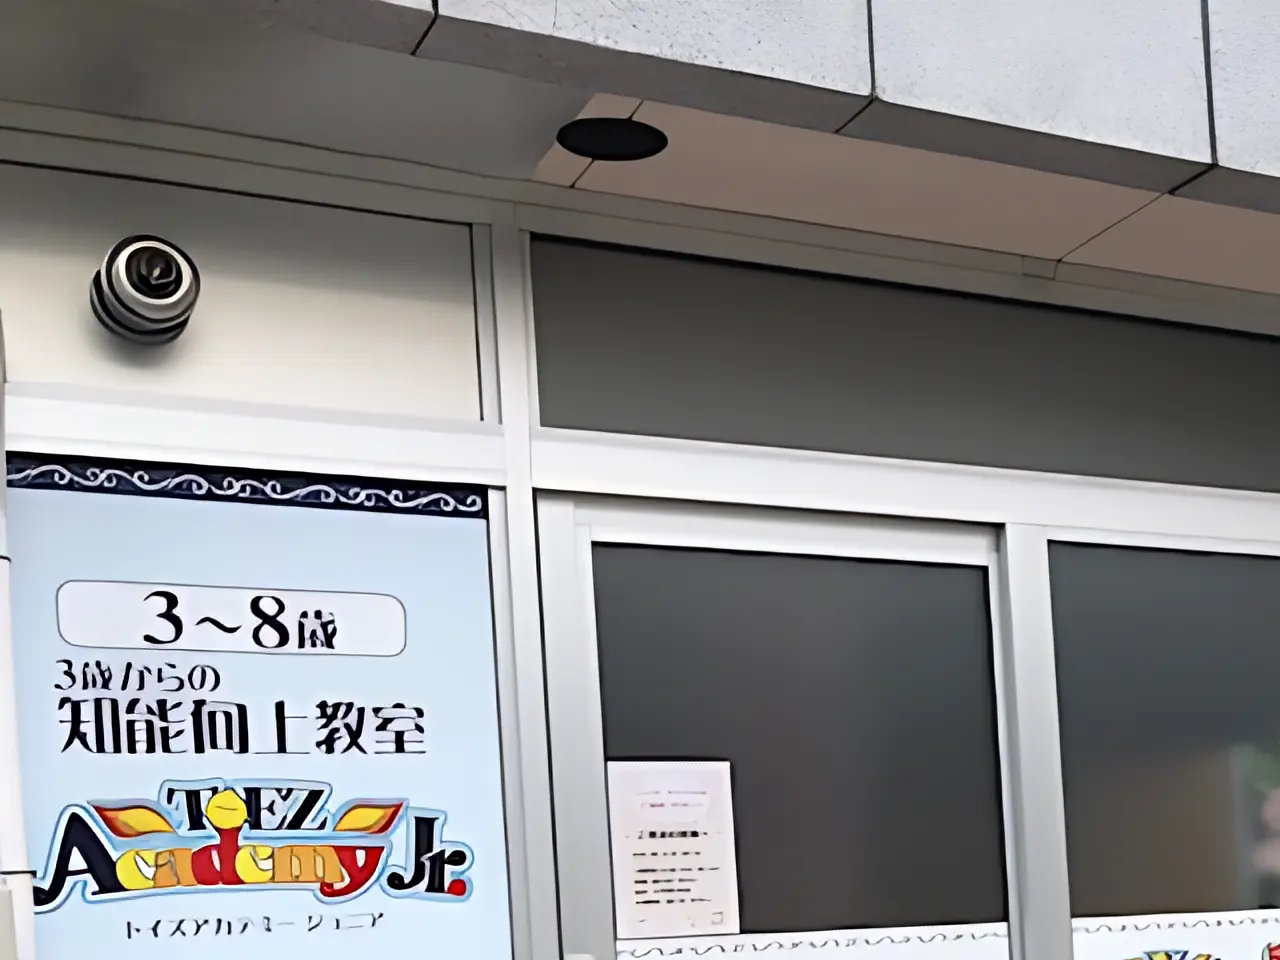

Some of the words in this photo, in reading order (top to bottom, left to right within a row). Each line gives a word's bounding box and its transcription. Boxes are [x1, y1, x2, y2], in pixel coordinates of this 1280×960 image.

[57, 697, 428, 754] 知能向上教室
